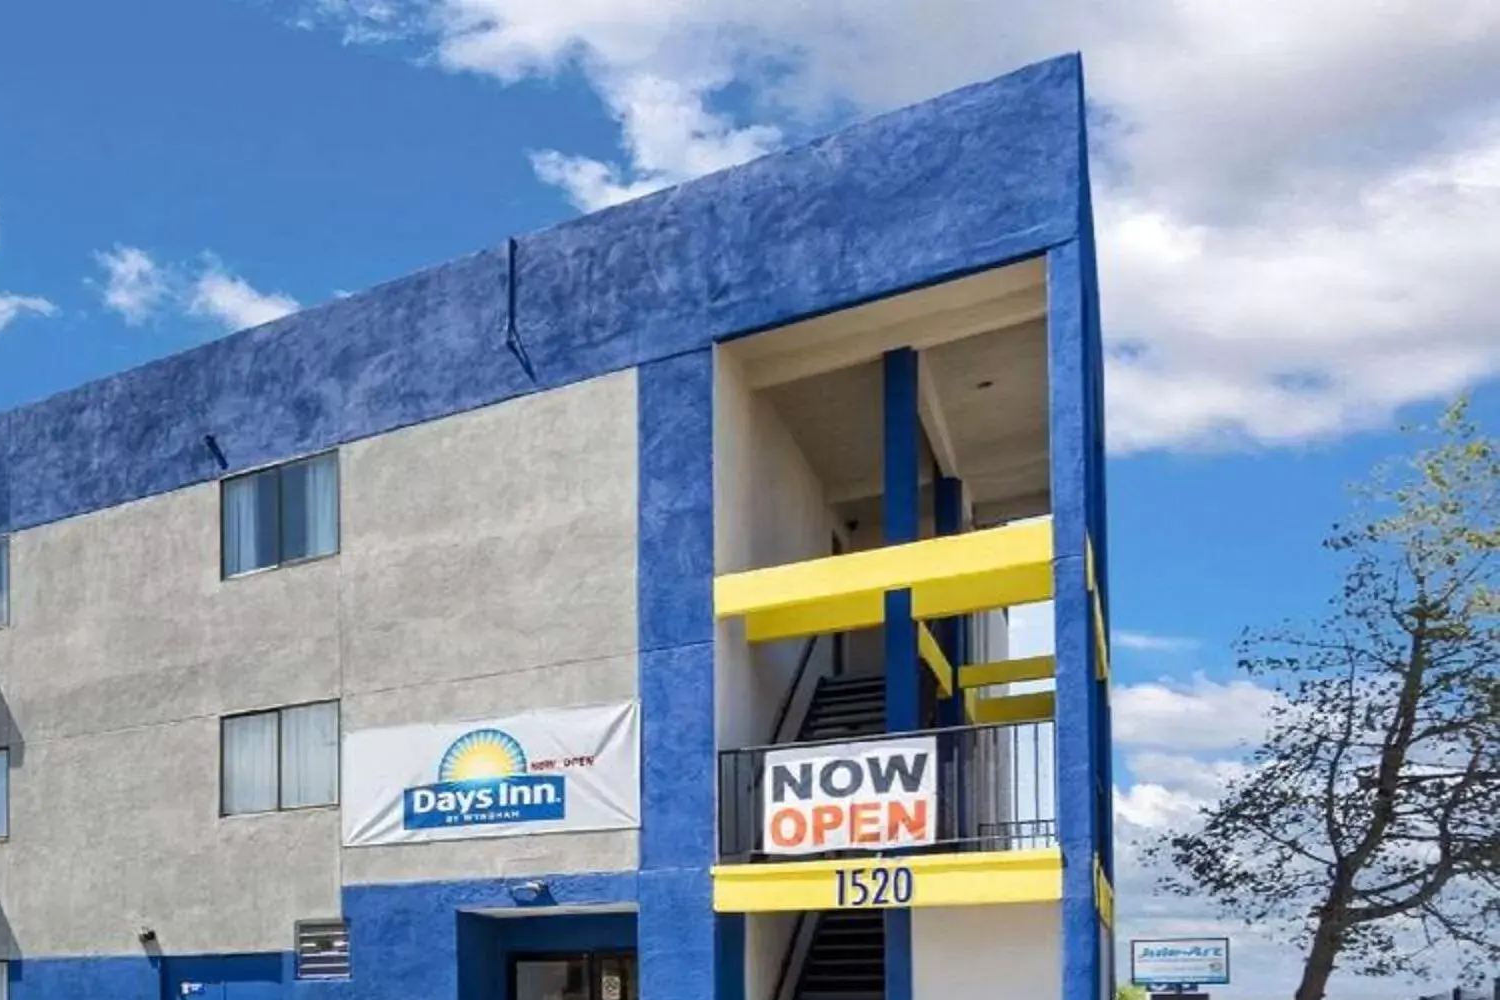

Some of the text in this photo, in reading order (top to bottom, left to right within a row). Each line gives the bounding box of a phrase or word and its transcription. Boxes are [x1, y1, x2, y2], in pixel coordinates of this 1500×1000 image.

[563, 755, 595, 768] OPEN
[772, 753, 928, 802] NOW
[413, 786, 493, 814] Days
[770, 800, 927, 848] OPEN
[836, 867, 913, 906] 1520
